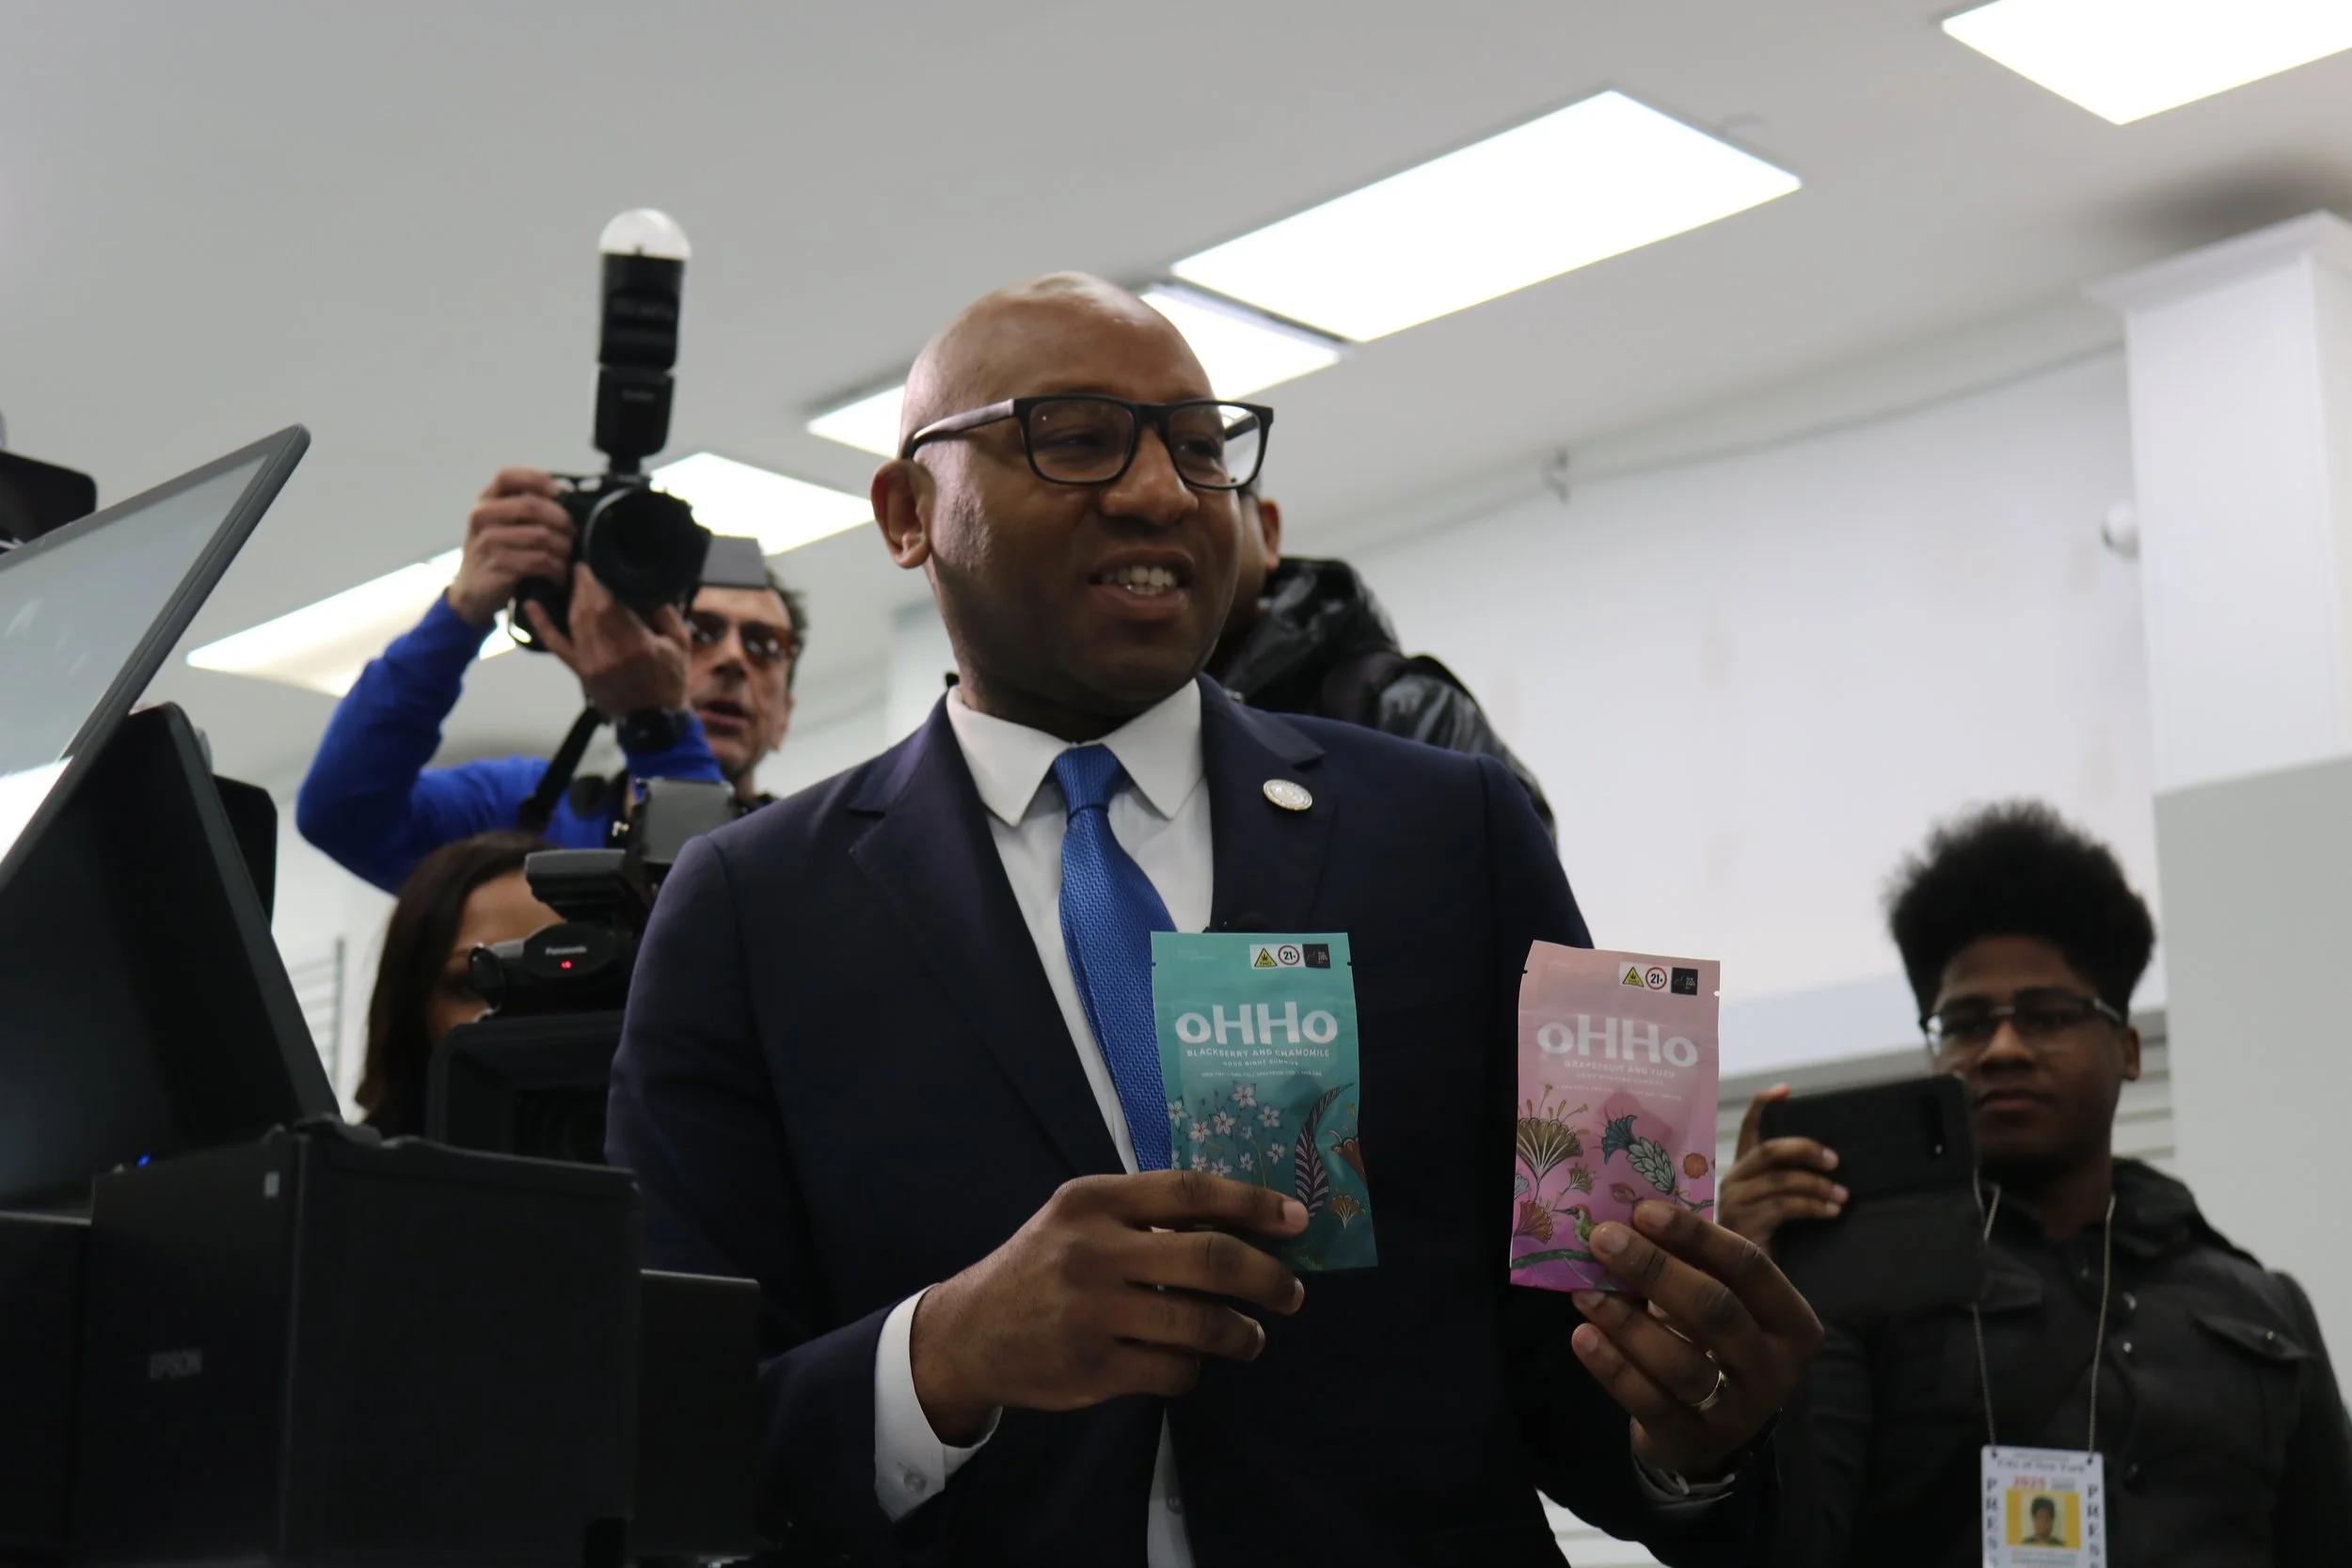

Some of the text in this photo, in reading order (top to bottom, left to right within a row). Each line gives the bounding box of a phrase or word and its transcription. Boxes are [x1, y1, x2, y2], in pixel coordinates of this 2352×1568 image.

[1650, 973, 1663, 985] 21+
[1176, 1001, 1338, 1045] oHHo
[1537, 1014, 1698, 1067] oHHo
[1186, 1048, 1329, 1058] BLACKBERRY AND CHAMOMILE
[1565, 1059, 1675, 1078] GRAPEFRUIT AND YUZU
